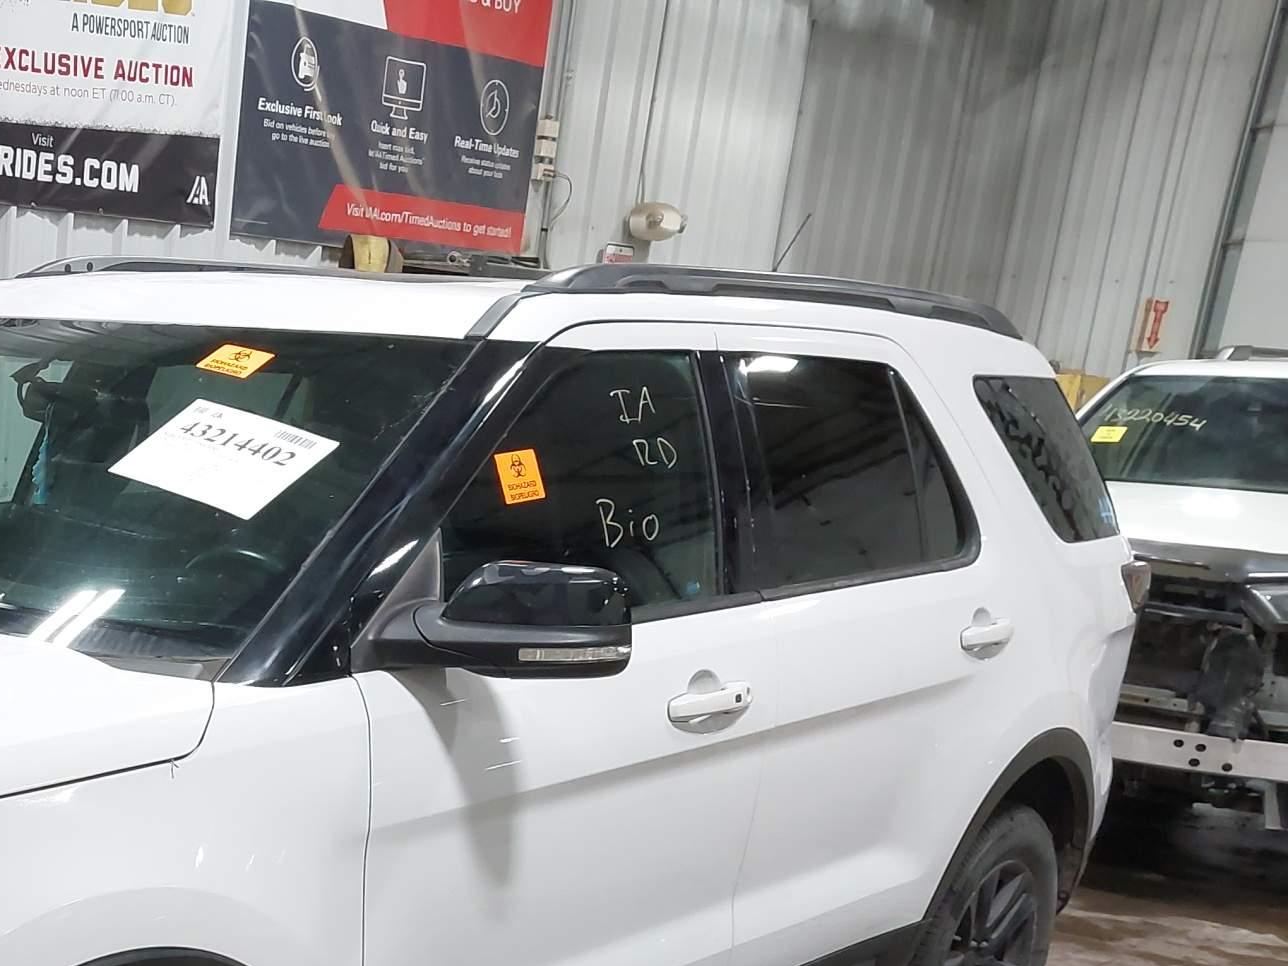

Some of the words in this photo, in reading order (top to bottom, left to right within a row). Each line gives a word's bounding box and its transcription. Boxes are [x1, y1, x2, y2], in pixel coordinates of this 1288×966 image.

[72, 12, 79, 32] A
[82, 14, 150, 39] POWERSPORT
[151, 22, 190, 45] AUCTION
[113, 59, 194, 88] AUCTION
[49, 86, 60, 96] at
[63, 87, 89, 98] noon
[92, 87, 107, 99] ET
[257, 97, 302, 117] Exclusive
[263, 118, 275, 128] Bid
[370, 119, 390, 136] Quick
[391, 125, 407, 138] and
[409, 128, 429, 144] Easy
[31, 132, 55, 148] Visit
[454, 135, 492, 153] Real-Time
[493, 143, 520, 158] Updates
[346, 202, 364, 218] Visit
[462, 221, 471, 233] to
[472, 224, 486, 237] get
[609, 386, 656, 424] IA
[180, 421, 296, 466] 43214402
